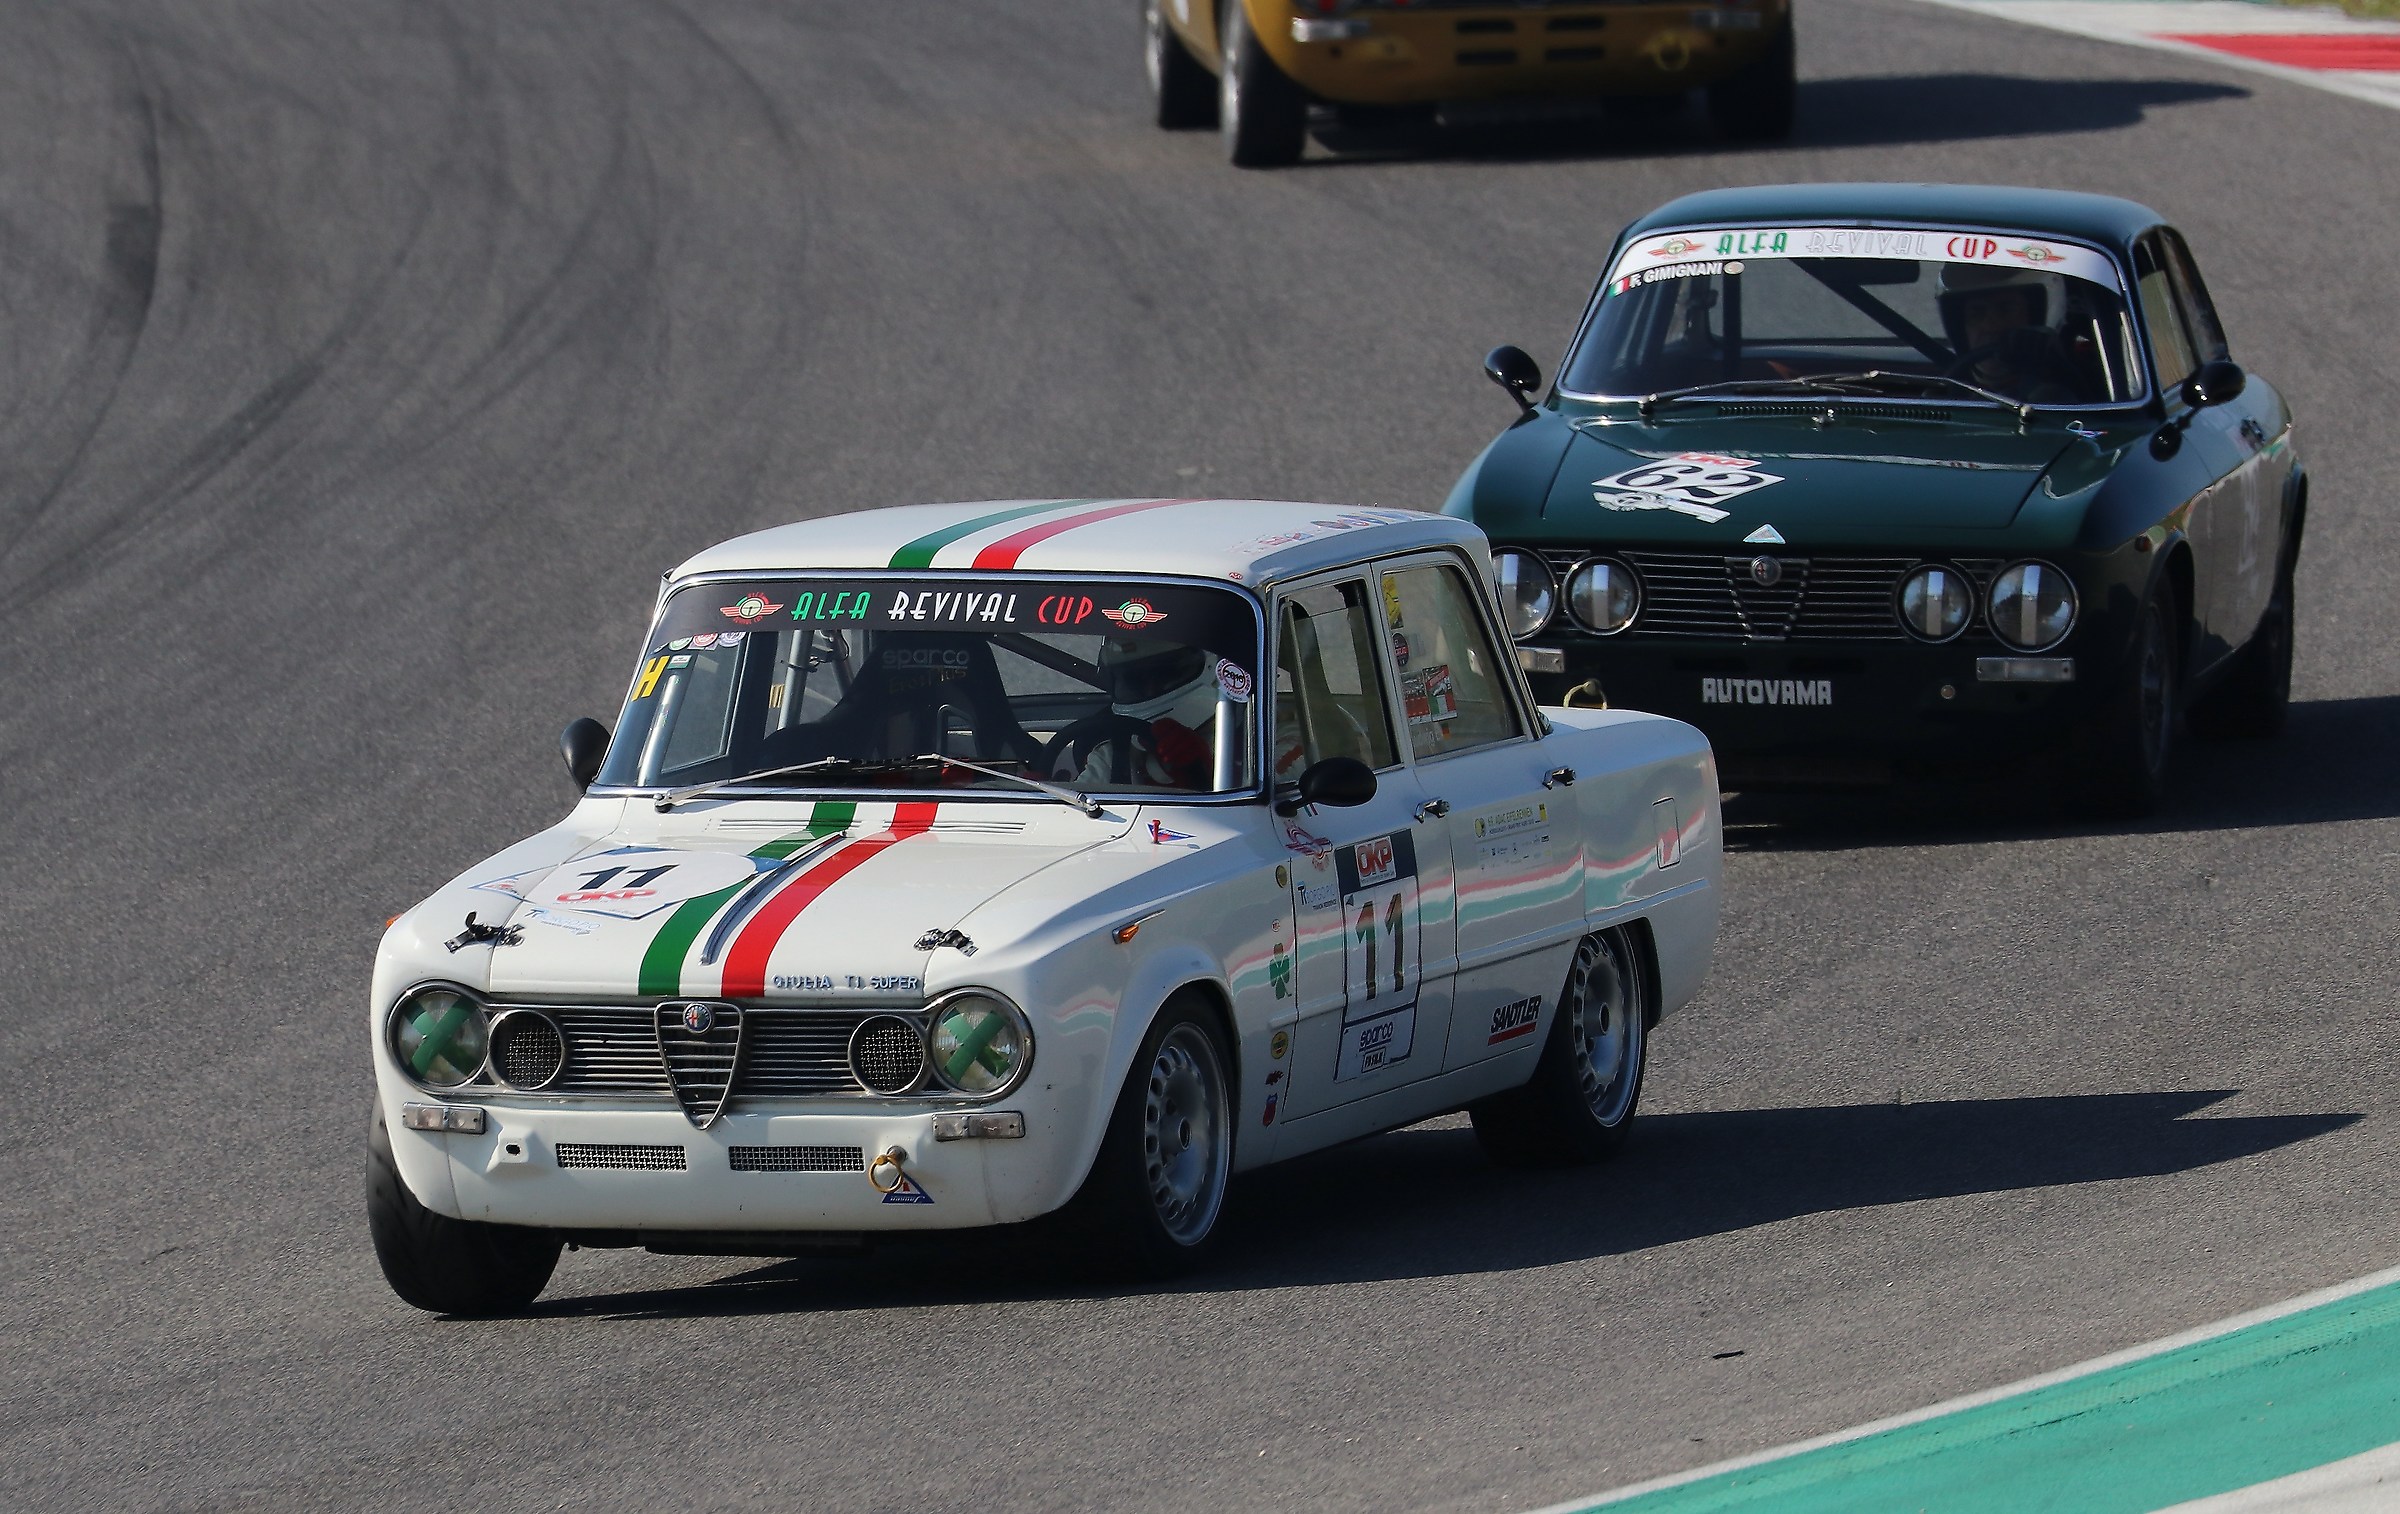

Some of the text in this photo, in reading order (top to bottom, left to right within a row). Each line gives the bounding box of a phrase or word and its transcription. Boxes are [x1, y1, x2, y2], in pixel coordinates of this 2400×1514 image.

[1716, 231, 1998, 260] ALFA REVIVAL CUP
[1630, 262, 1722, 288] F. GIMIGNANI
[1616, 464, 1764, 499] 62
[790, 590, 1094, 625] ALFA REVIVAL CUP
[631, 655, 671, 701] H
[1702, 677, 1833, 706] AUTOVAMA
[1356, 839, 1393, 878] OKP
[577, 864, 680, 891] 11
[556, 889, 658, 902] OKP
[1355, 892, 1404, 1001] 11
[772, 973, 920, 989] GIULIA TI SUPER
[1490, 994, 1542, 1034] SANDTLER
[1360, 1021, 1394, 1048] sparco
